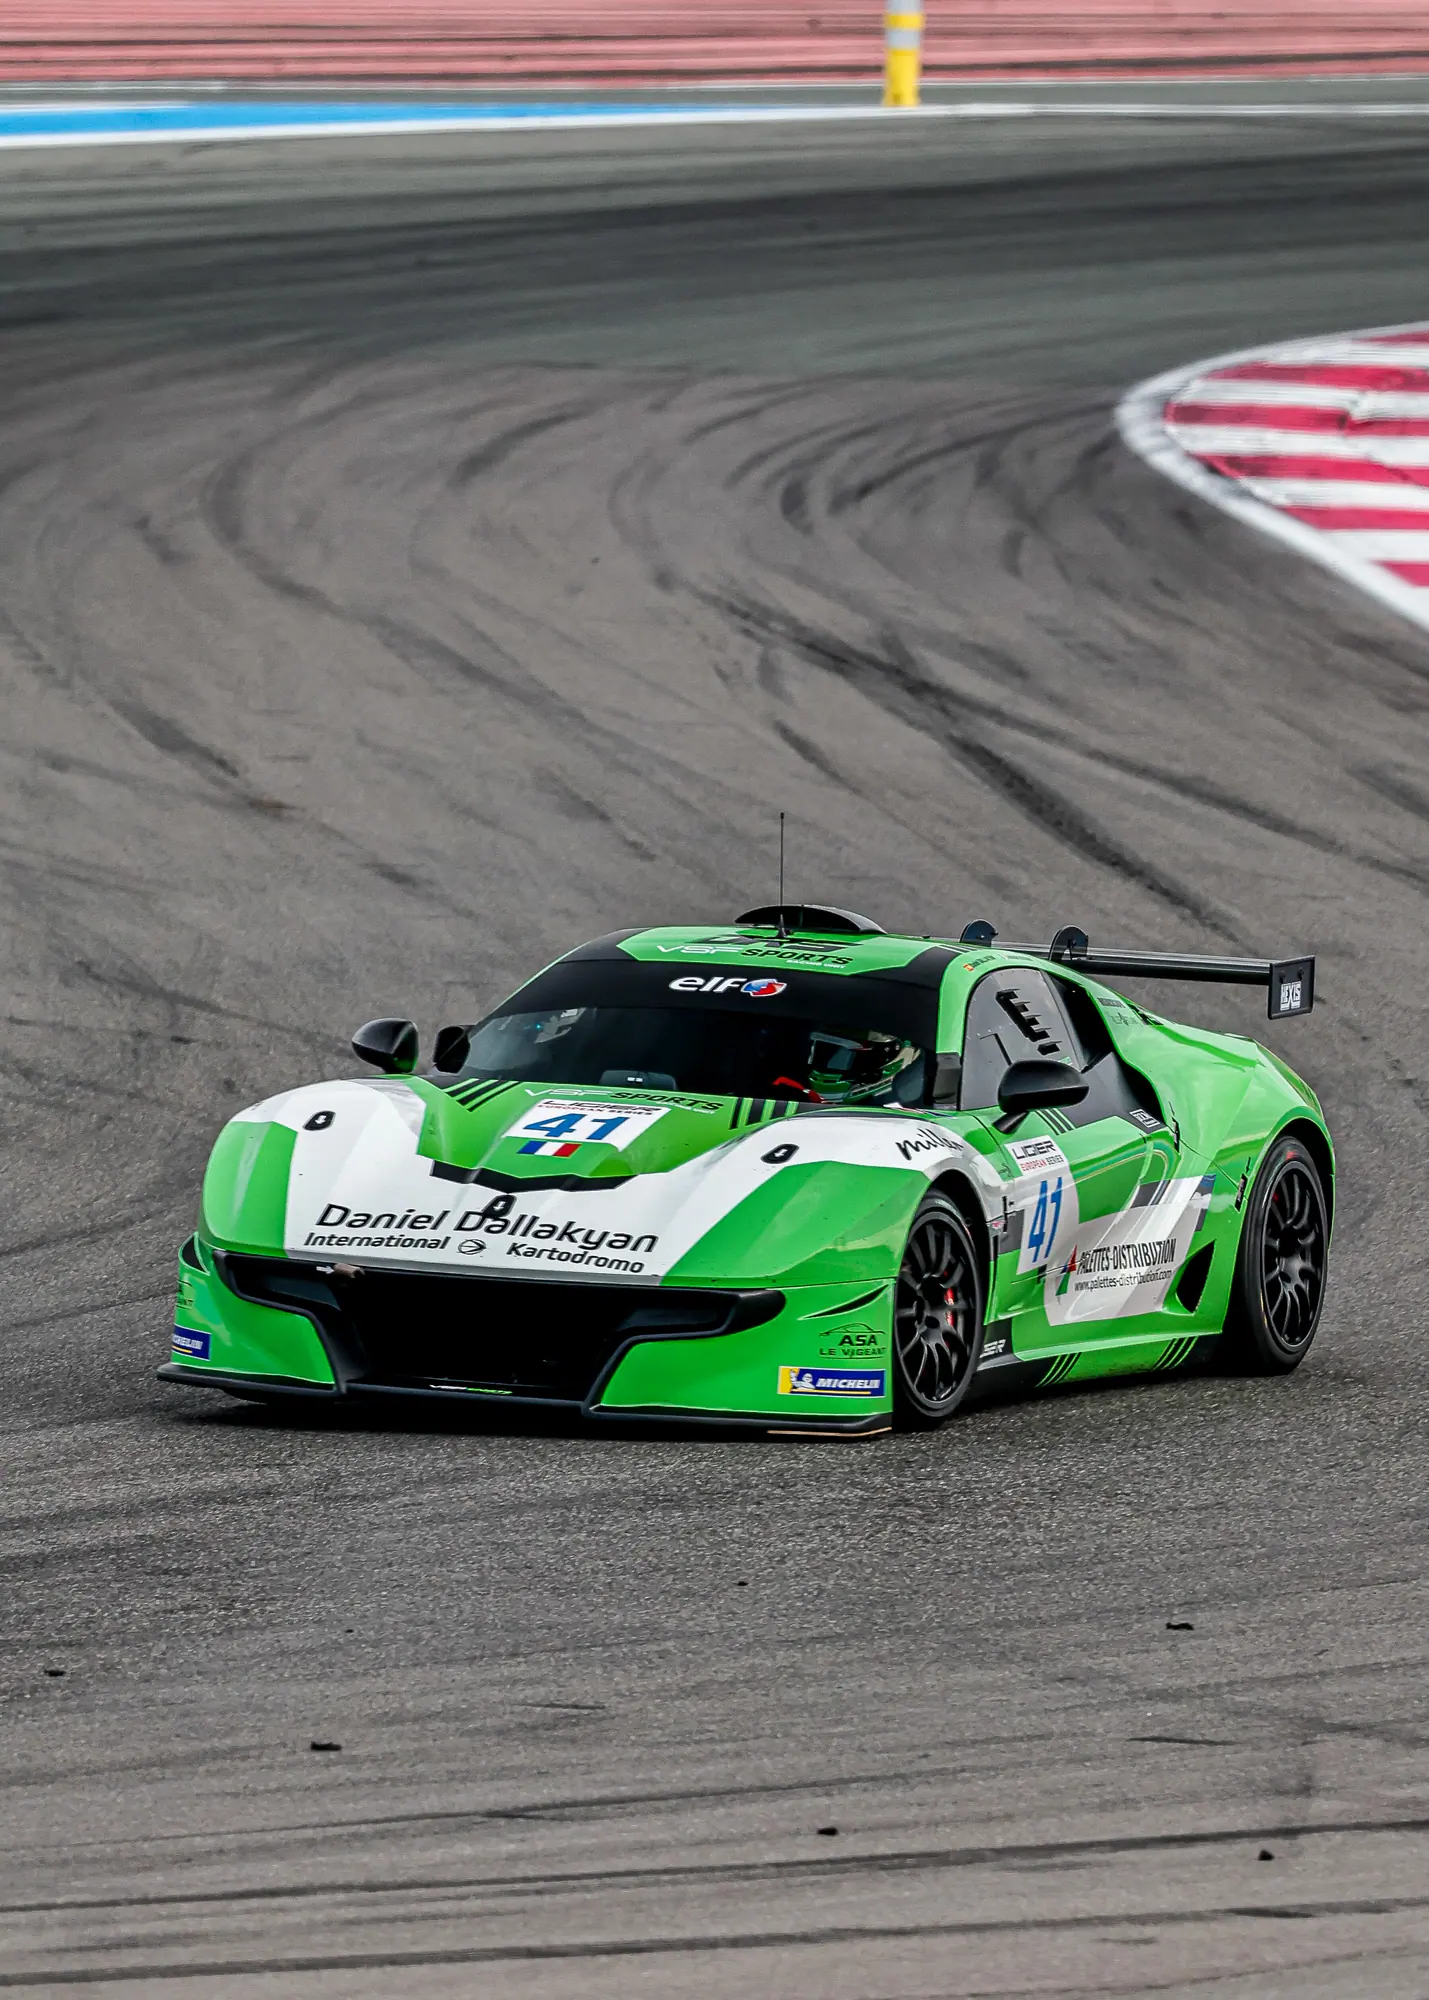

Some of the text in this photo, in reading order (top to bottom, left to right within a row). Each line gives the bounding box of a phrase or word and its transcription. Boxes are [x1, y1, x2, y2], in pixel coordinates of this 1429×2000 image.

[657, 945, 853, 965] VSF SPORTS
[669, 976, 748, 993] elf
[1280, 981, 1301, 1011] HEXIS
[524, 1088, 613, 1097] VSF
[610, 1091, 724, 1111] SPORTS
[522, 1113, 630, 1140] 41
[315, 1203, 659, 1253] Daniel Dallakyan
[1028, 1176, 1063, 1263] 41
[303, 1232, 645, 1273] International Kartodromo
[1076, 1238, 1177, 1275] PALETTES-DISTRIBUTION
[1074, 1268, 1173, 1292] www.palettes-distribution.com
[819, 1348, 836, 1356] LE
[838, 1335, 878, 1346] ASA
[816, 1378, 880, 1388] MICHELIN
